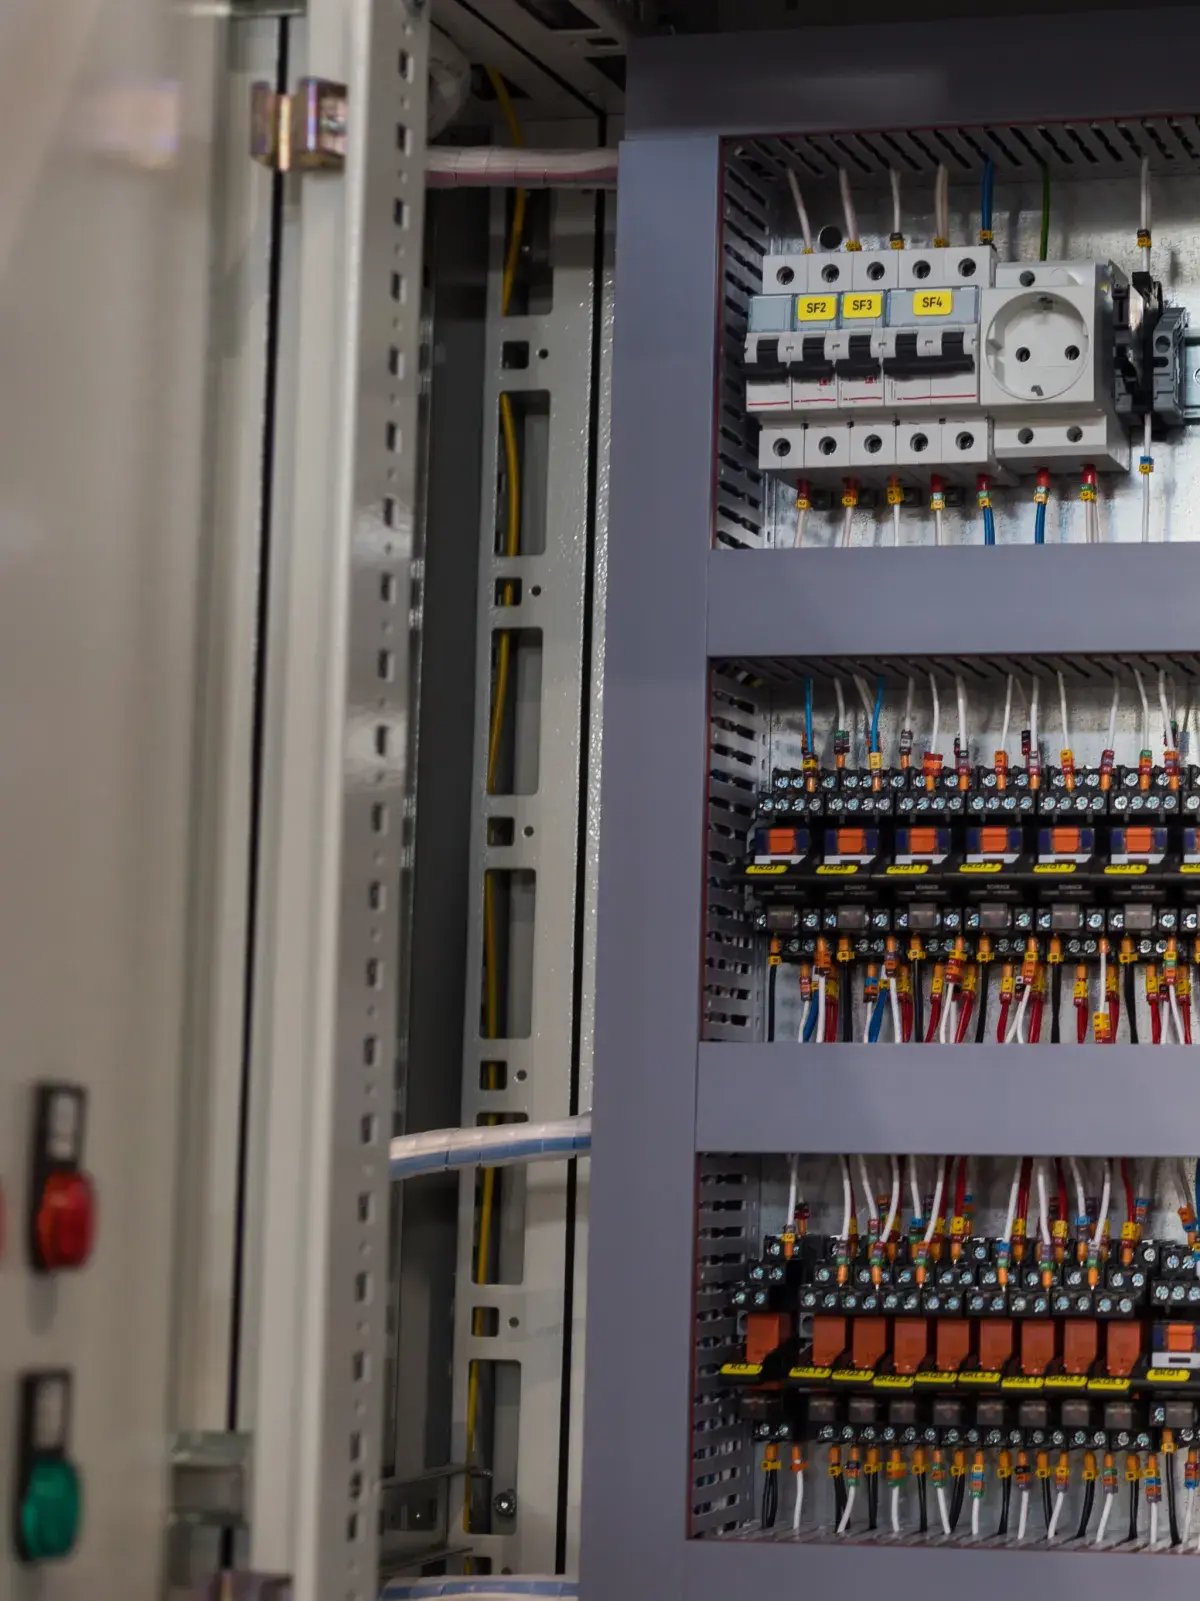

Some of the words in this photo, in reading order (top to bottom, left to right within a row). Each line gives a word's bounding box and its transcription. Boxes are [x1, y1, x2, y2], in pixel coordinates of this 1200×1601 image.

[852, 300, 872, 311] SF3
[922, 296, 942, 308] SF4
[806, 303, 826, 314] SF2
